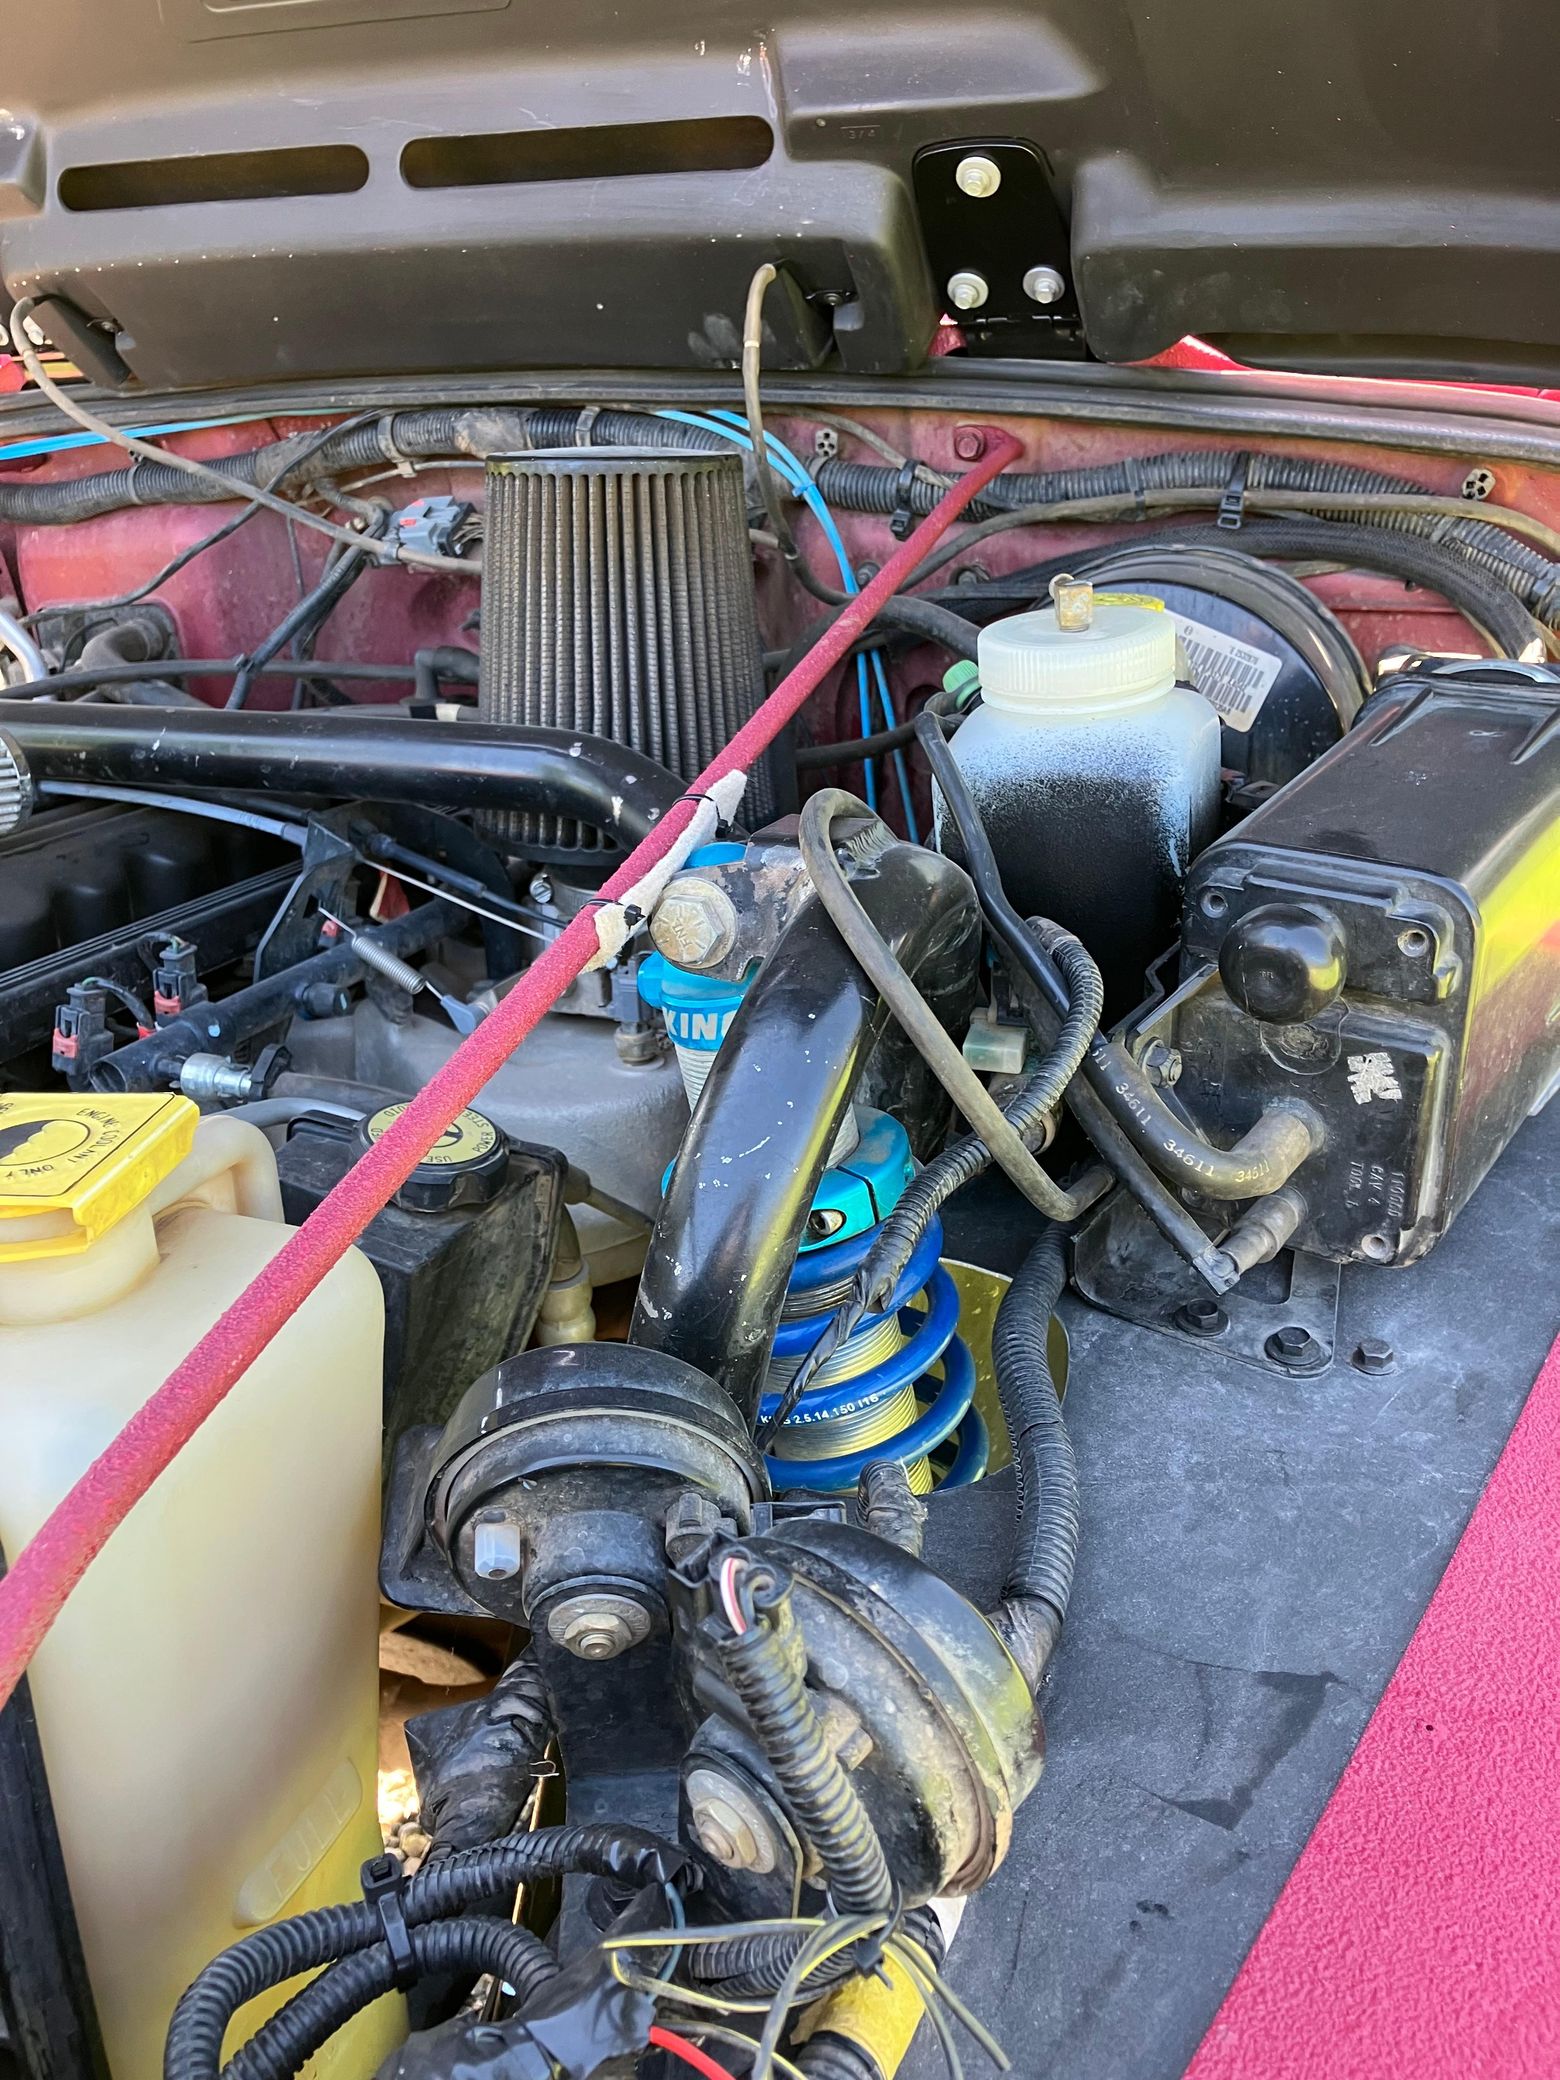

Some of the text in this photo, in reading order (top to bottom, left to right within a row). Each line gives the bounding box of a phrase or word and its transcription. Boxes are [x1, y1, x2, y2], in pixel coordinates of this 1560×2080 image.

[76, 1107, 120, 1128] ENGINE
[461, 1110, 494, 1153] POWER STEE
[1115, 1082, 1152, 1126] 34611
[1163, 1139, 1215, 1177] 34611
[67, 1129, 120, 1163] COOLANT
[426, 1155, 453, 1163] USE
